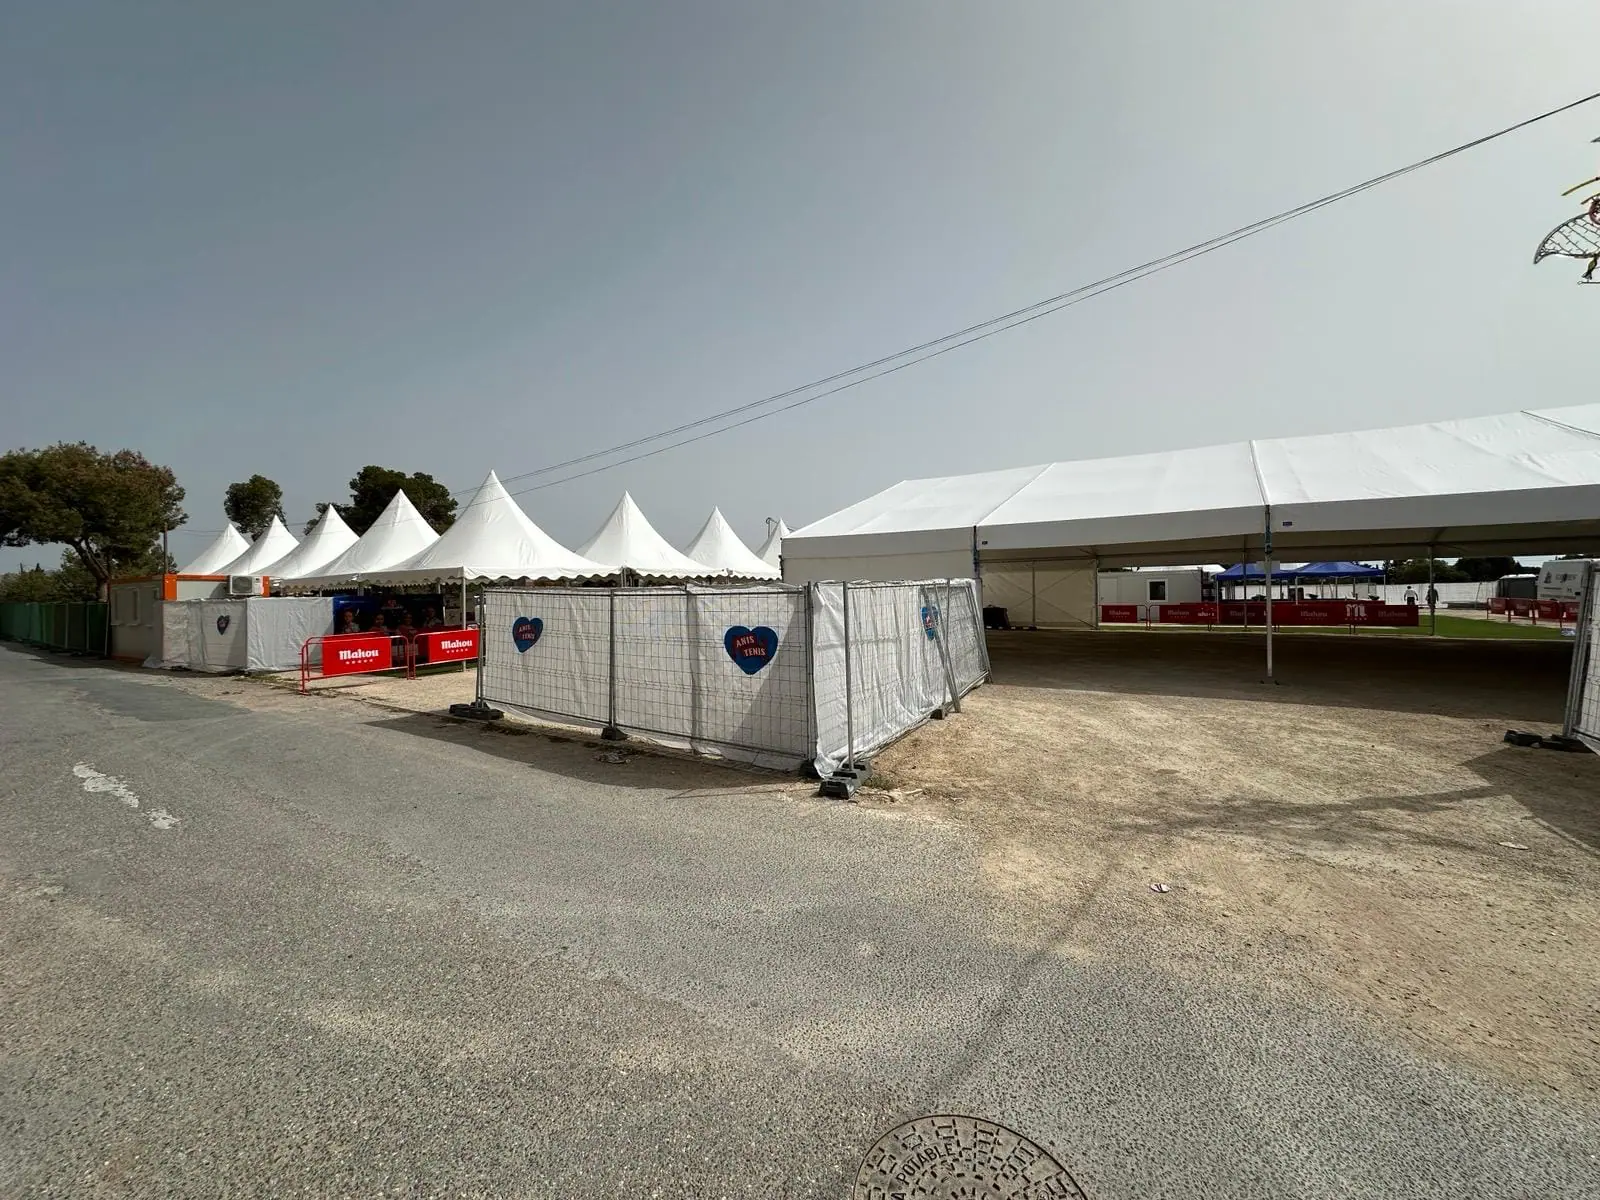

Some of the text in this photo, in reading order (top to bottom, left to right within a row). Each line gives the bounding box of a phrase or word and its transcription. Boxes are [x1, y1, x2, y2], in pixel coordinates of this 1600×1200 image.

[441, 639, 473, 650] Mahou
[736, 635, 755, 648] ANIS
[339, 648, 379, 661] Mahou
[744, 647, 766, 657] TENIS
[896, 1142, 956, 1185] POTABLE
